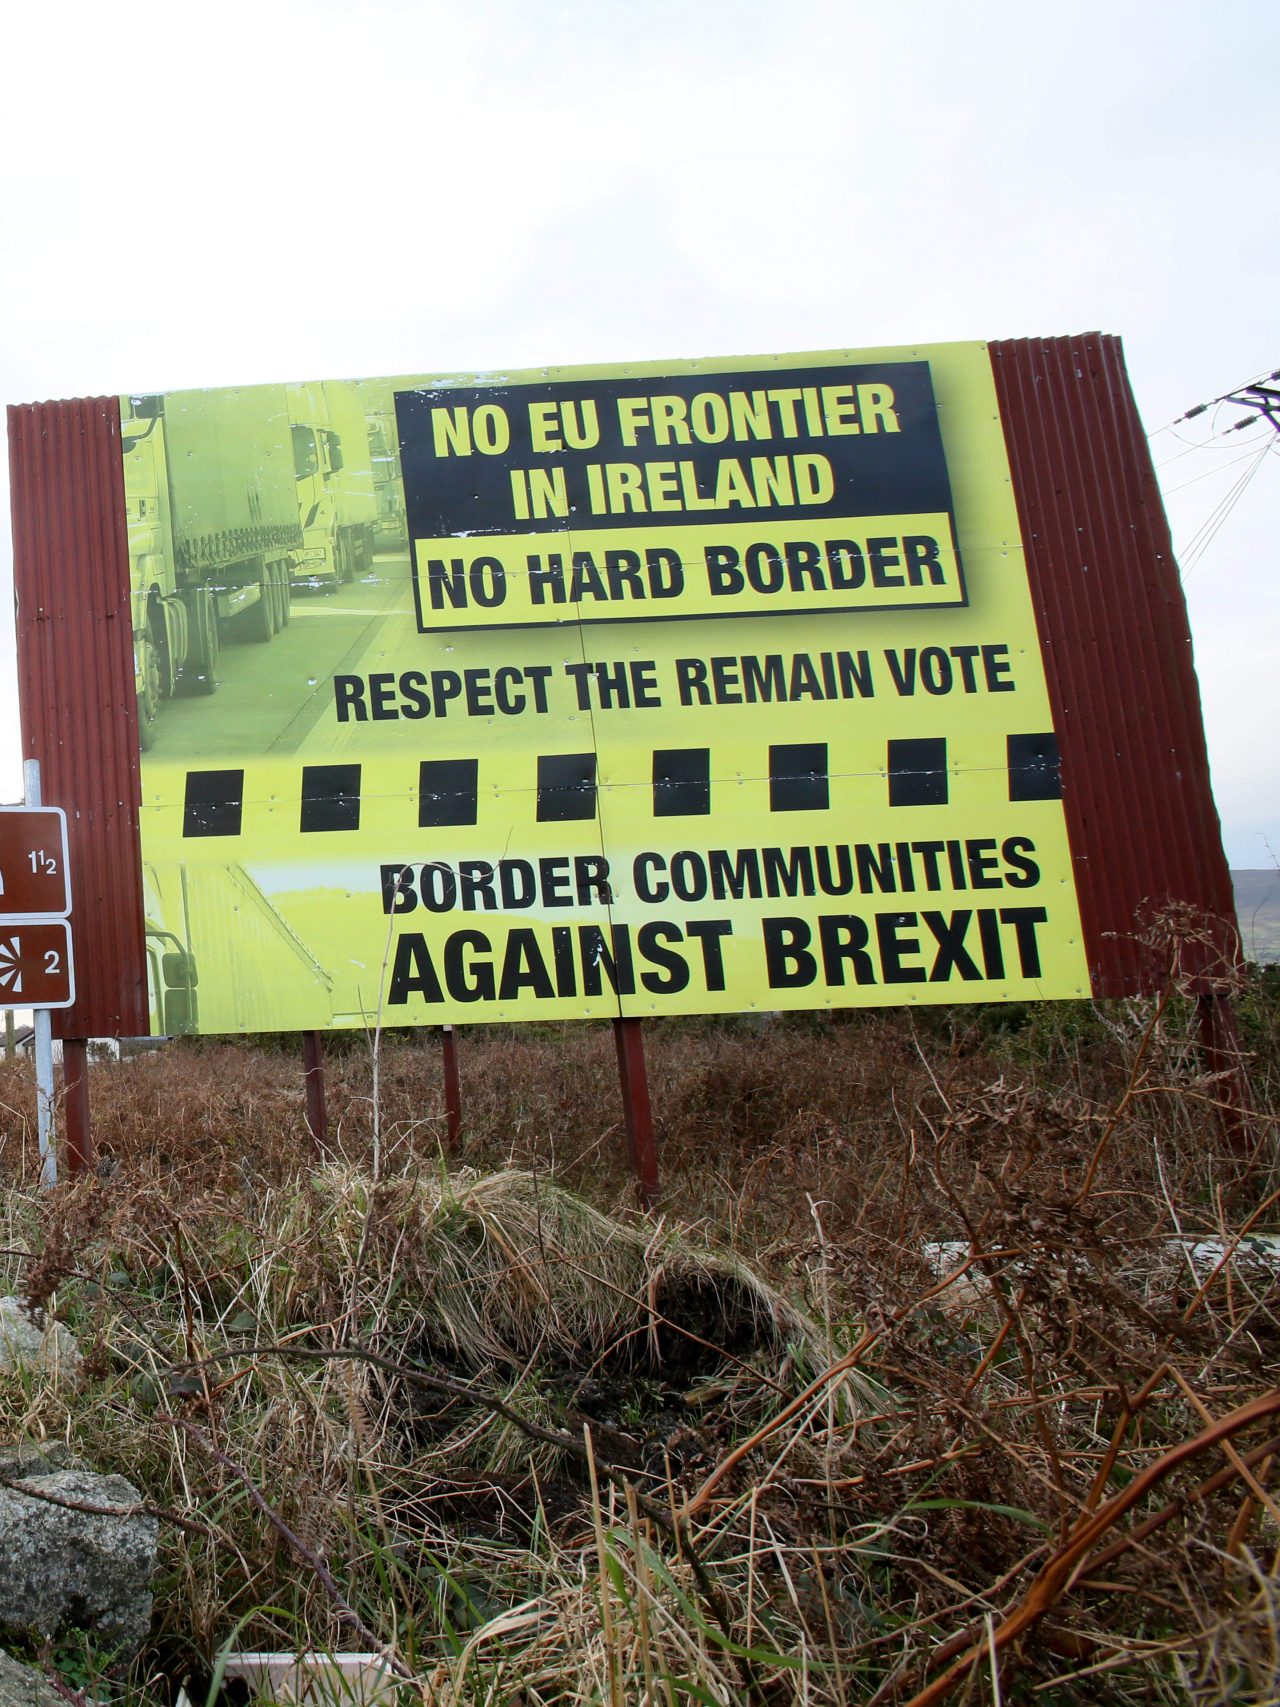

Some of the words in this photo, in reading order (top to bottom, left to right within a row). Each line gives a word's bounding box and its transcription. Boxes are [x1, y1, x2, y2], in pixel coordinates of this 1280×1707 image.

[431, 404, 511, 458] NO
[530, 398, 600, 452] EU
[618, 382, 901, 449] FRONTIER
[510, 466, 566, 521] IN
[590, 453, 835, 517] IRELAND
[427, 556, 508, 611] NO
[529, 546, 685, 605] HARD
[707, 534, 947, 597] BORDER
[333, 665, 553, 723] RESPECT
[565, 660, 662, 712] THE
[676, 651, 878, 707] REMAIN
[883, 643, 1016, 698] VOTE
[379, 855, 615, 915] BORDER
[632, 836, 1041, 904] COMMUNITIES
[43, 950, 61, 974] 2
[386, 919, 734, 1006] AGAINST
[762, 905, 1048, 990] BREXIT
